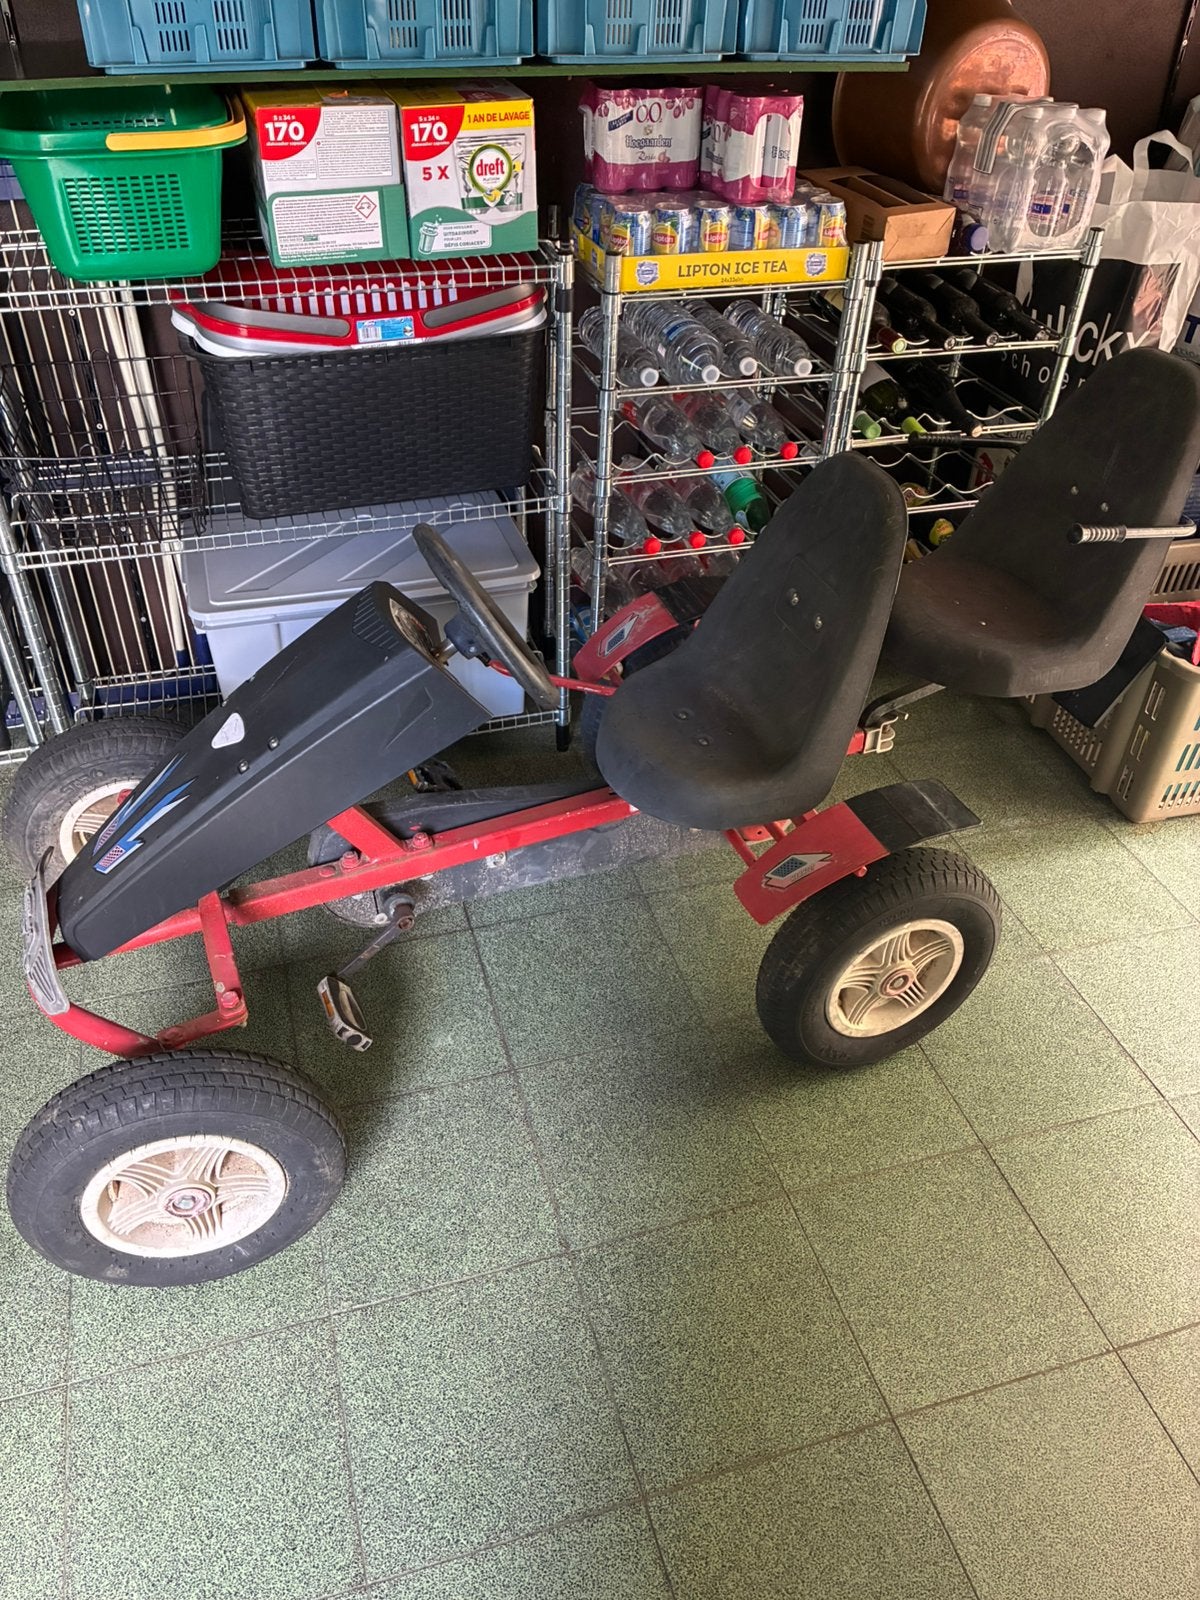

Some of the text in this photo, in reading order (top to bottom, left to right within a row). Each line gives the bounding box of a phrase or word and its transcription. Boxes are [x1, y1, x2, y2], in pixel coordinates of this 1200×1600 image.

[467, 111, 530, 123] 1 AN DE LAVAGE
[264, 121, 304, 141] 170
[410, 121, 448, 142] 170
[625, 134, 672, 149] Hoegaarden
[422, 165, 450, 181] 5 X
[476, 158, 505, 176] dreft
[653, 234, 675, 243] Lipton
[678, 260, 788, 278] LIPTON ICE TEA
